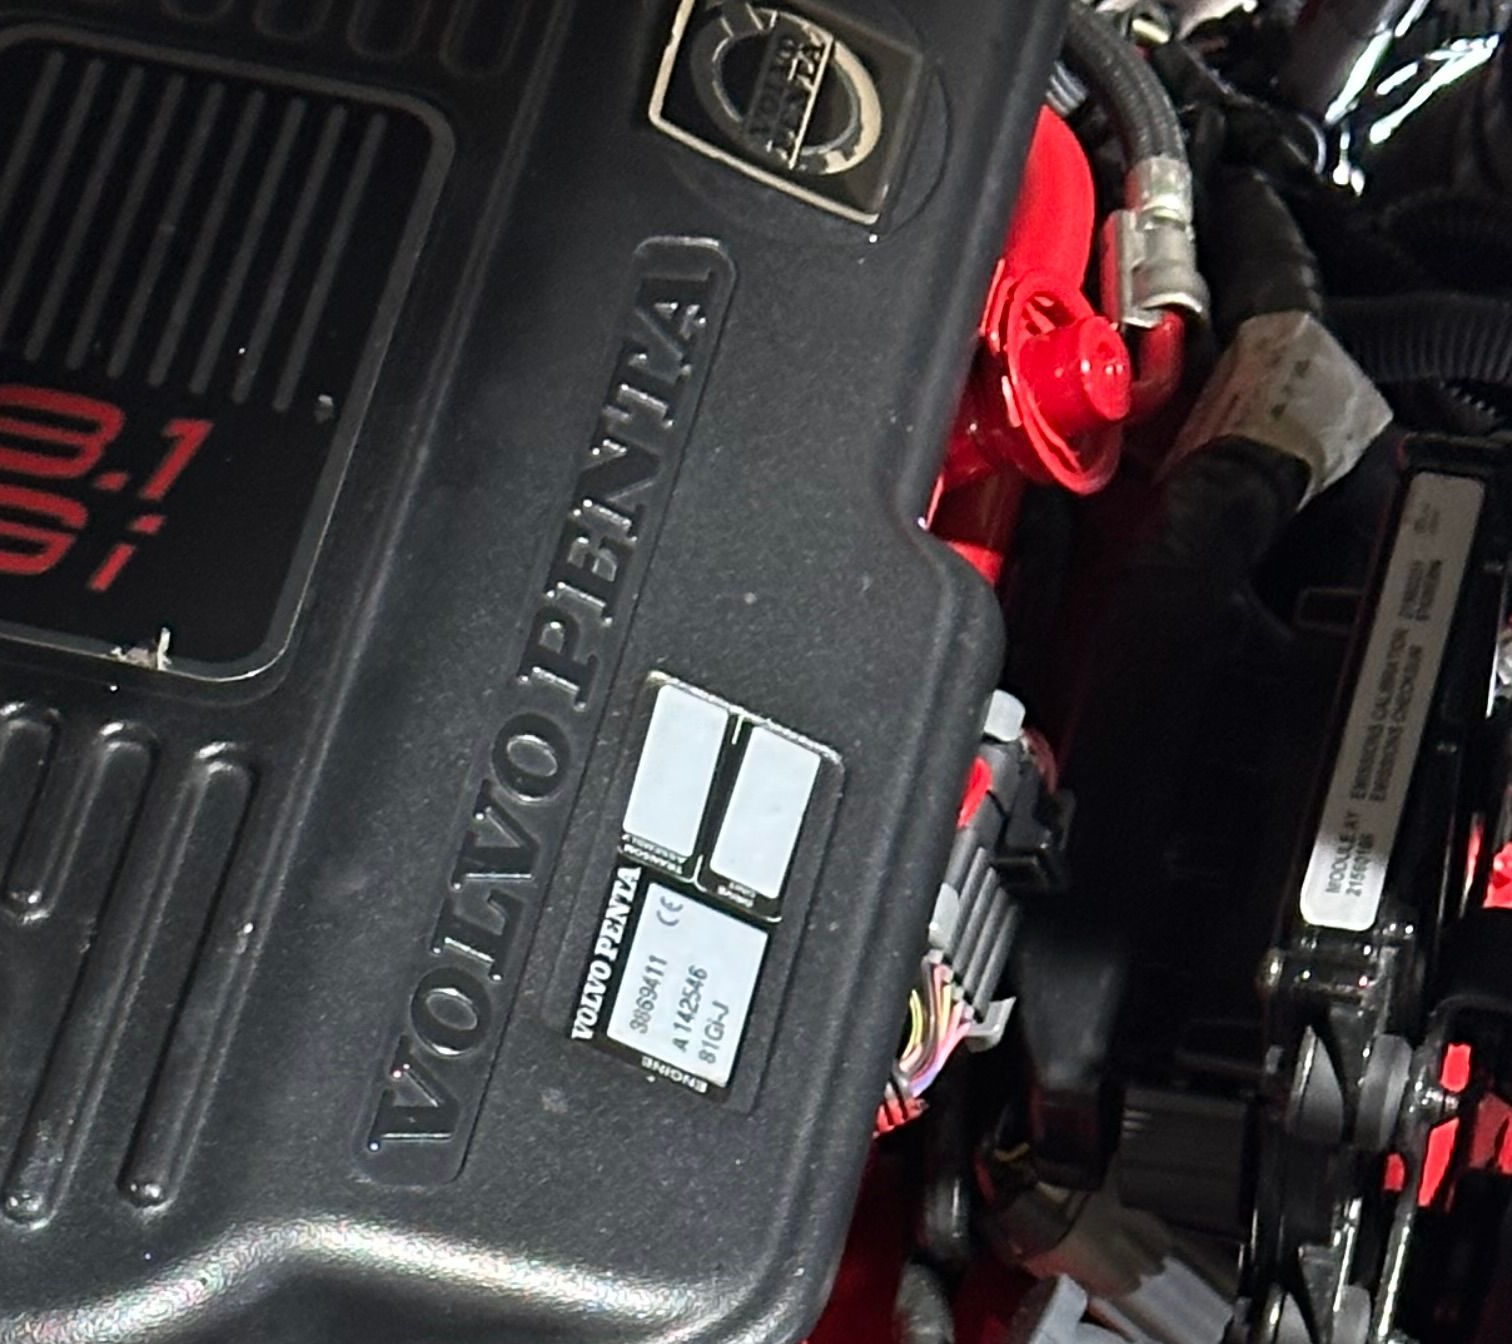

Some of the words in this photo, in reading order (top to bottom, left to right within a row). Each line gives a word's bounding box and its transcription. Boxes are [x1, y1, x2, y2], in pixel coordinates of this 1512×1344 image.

[369, 709, 576, 1152] VOLVO
[517, 260, 716, 710] PENTA
[571, 960, 613, 1040] VOLVO
[594, 867, 643, 962] PENTA
[641, 1055, 709, 1094] ENGINE
